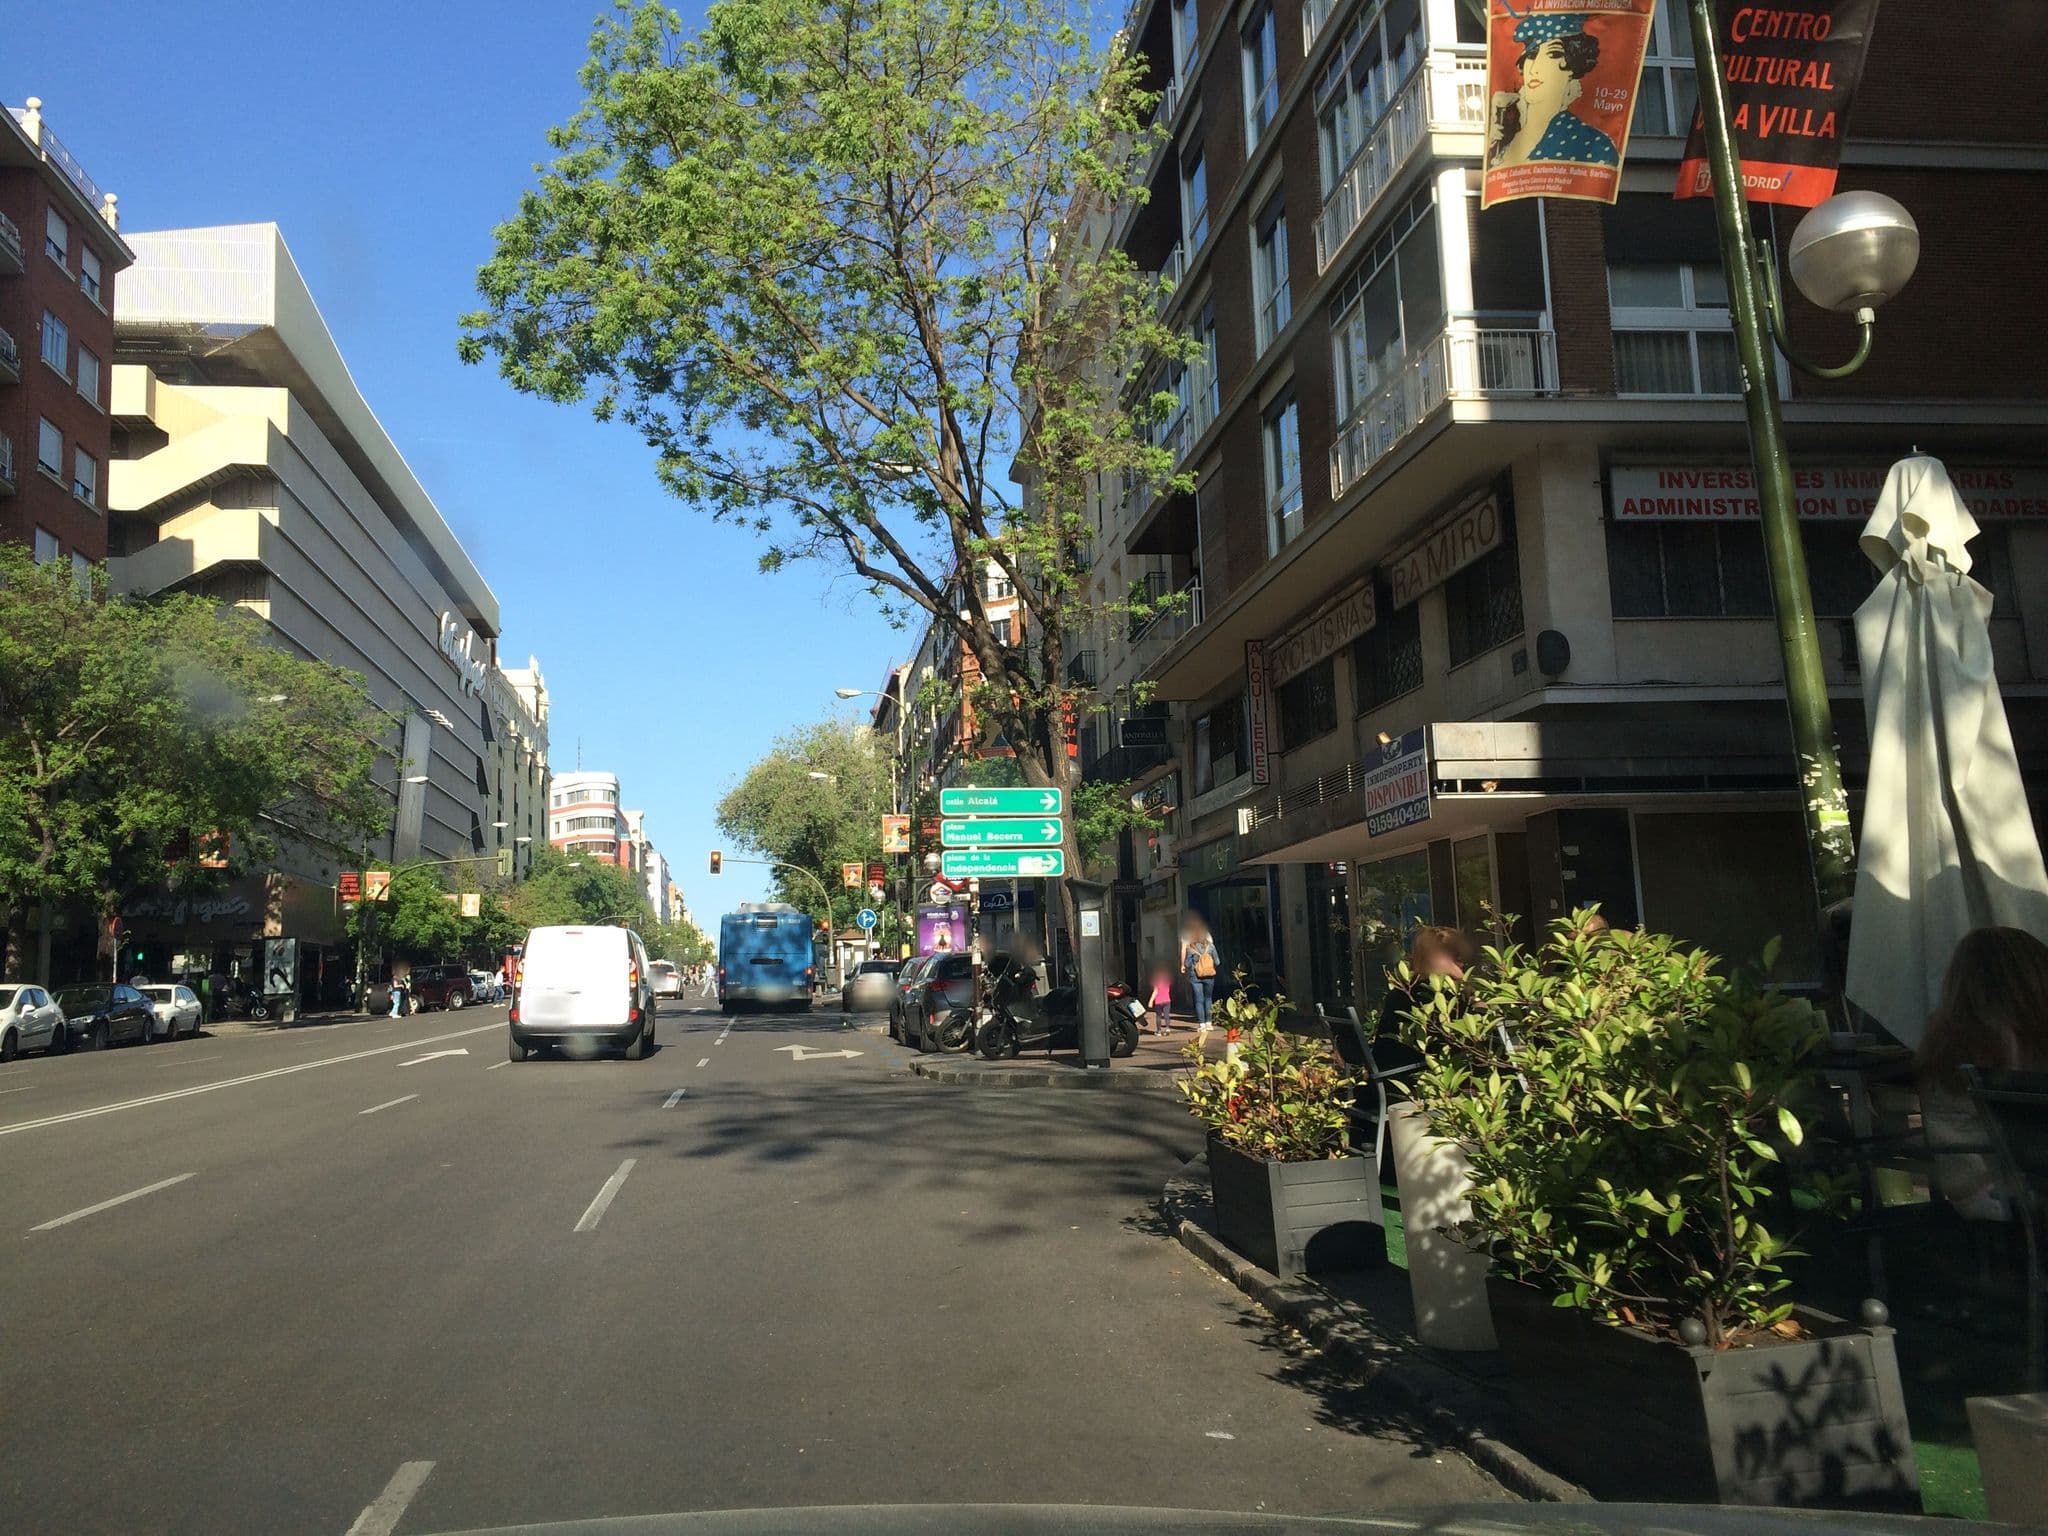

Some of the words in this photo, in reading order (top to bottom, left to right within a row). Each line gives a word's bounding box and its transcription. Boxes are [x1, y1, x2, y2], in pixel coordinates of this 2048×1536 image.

[1731, 7, 1831, 43] CENTRO
[1722, 54, 1834, 90] ULTURAL
[1593, 98, 1623, 112] Mayo
[1595, 87, 1628, 100] 10-29
[1759, 104, 1835, 138] VILLA
[1659, 471, 1824, 488] INVERSIES
[1622, 498, 1836, 516] ADMINISTRION
[1272, 590, 1373, 687] EXCLUSIVAS
[1394, 503, 1497, 602] RAMIRO
[1250, 643, 1266, 782] ALQUILERES
[1367, 754, 1423, 787] INMOPROPERTY
[1367, 769, 1427, 812] DISPONIBLE
[1369, 800, 1429, 835] 915940422
[946, 832, 982, 841] Manuel
[987, 832, 1024, 841] Becerra
[946, 863, 1017, 873] Independencia
[970, 853, 979, 861] de
